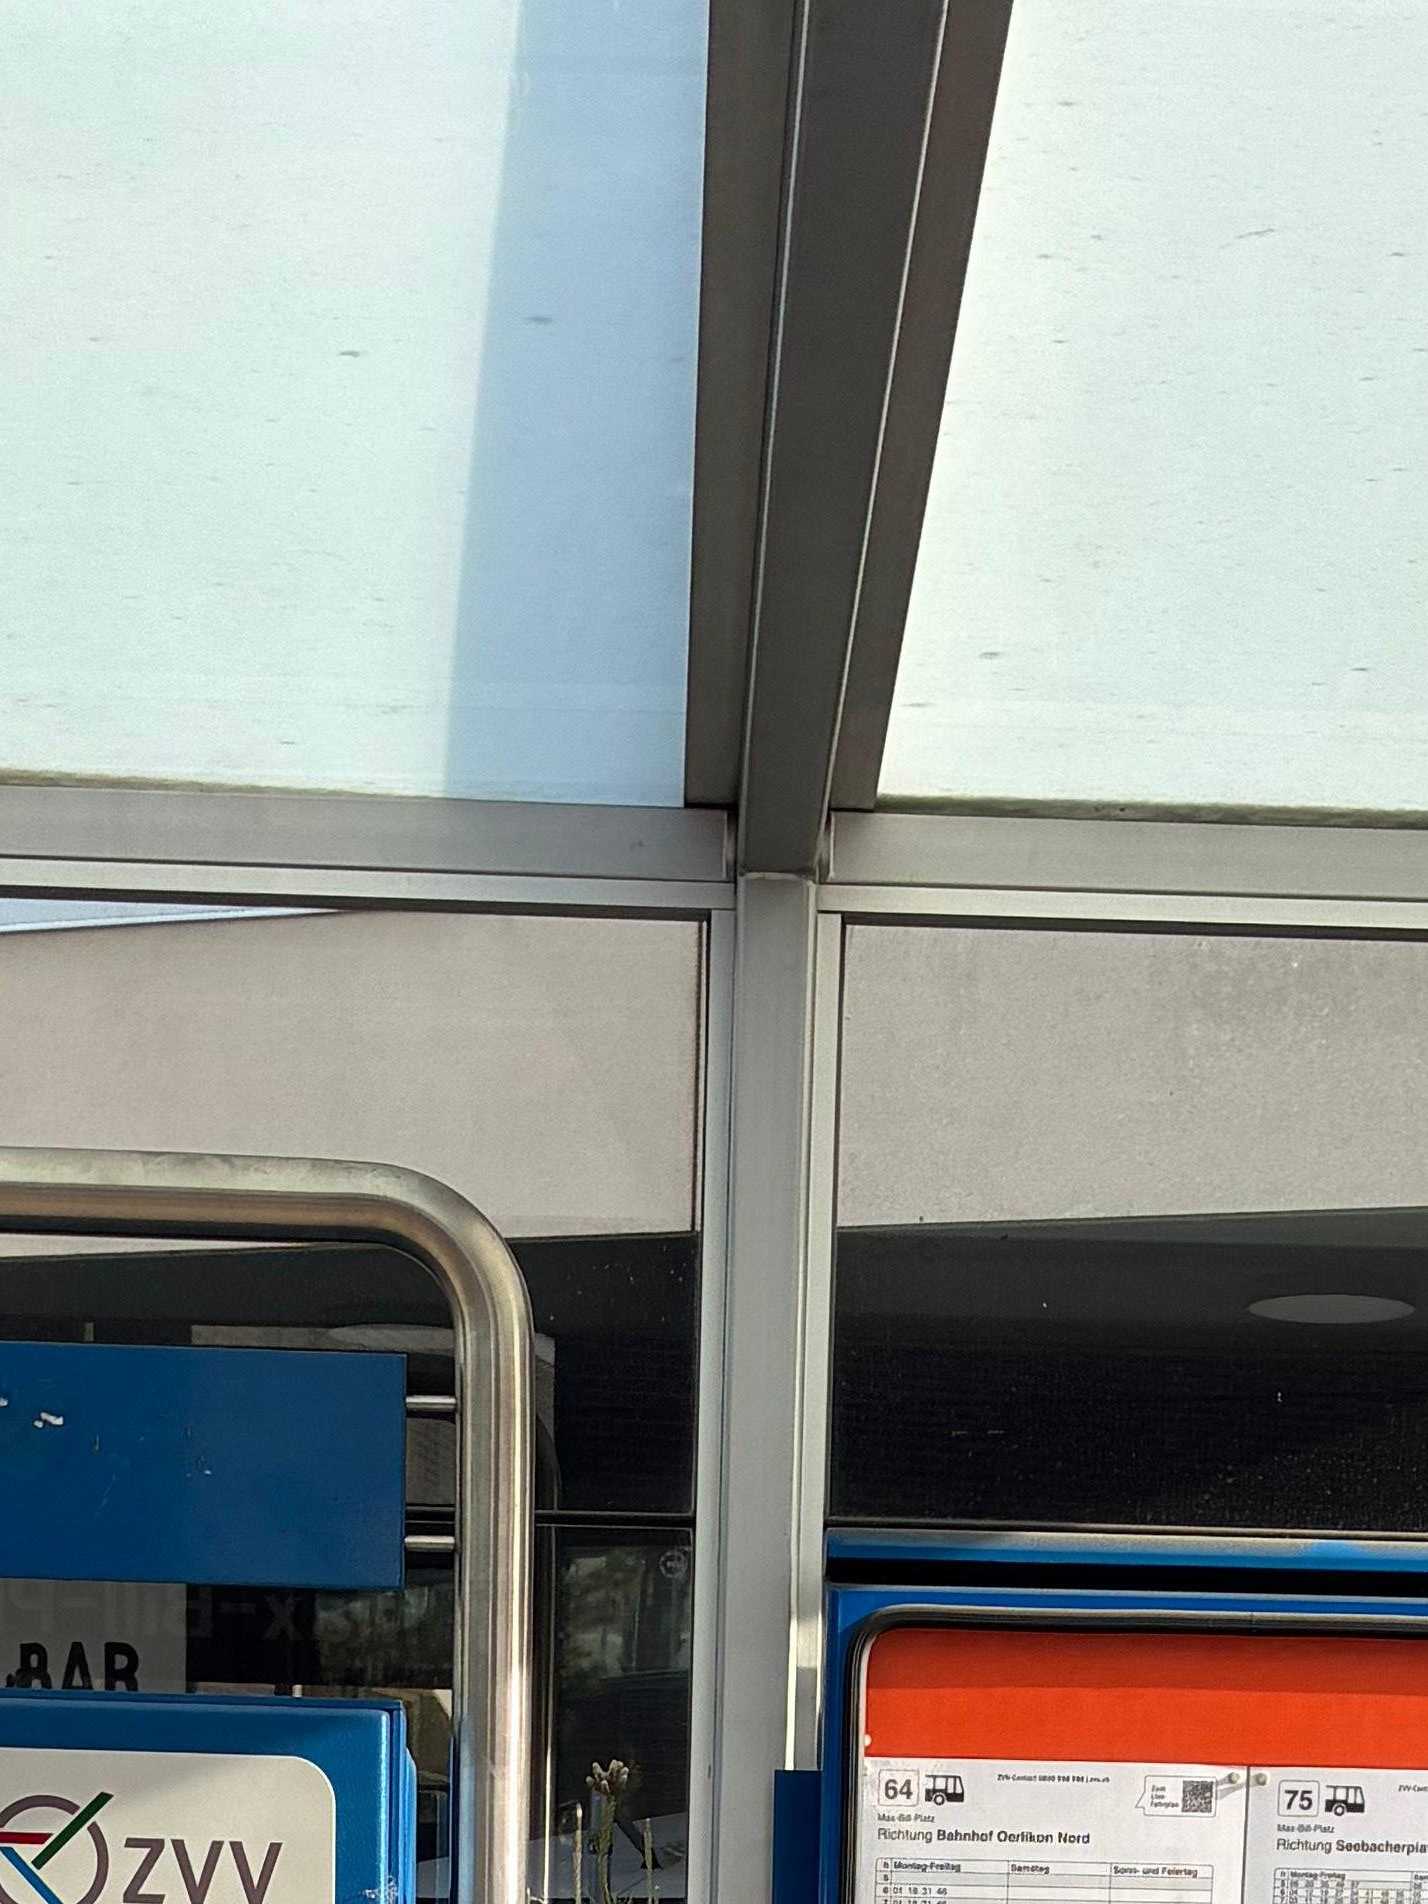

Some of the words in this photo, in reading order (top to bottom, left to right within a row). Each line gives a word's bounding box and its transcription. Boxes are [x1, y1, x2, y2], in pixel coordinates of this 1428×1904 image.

[884, 1779, 913, 1800] 64
[1284, 1790, 1313, 1811] 75
[878, 1828, 933, 1843] Richtung
[937, 1829, 993, 1842] Bahnhof
[997, 1831, 1054, 1843] Oerlikon
[1058, 1832, 1090, 1844] Nord
[1277, 1838, 1332, 1854] Richtung
[1011, 1864, 1050, 1874] Samstag
[1161, 1867, 1198, 1878] Feiertag
